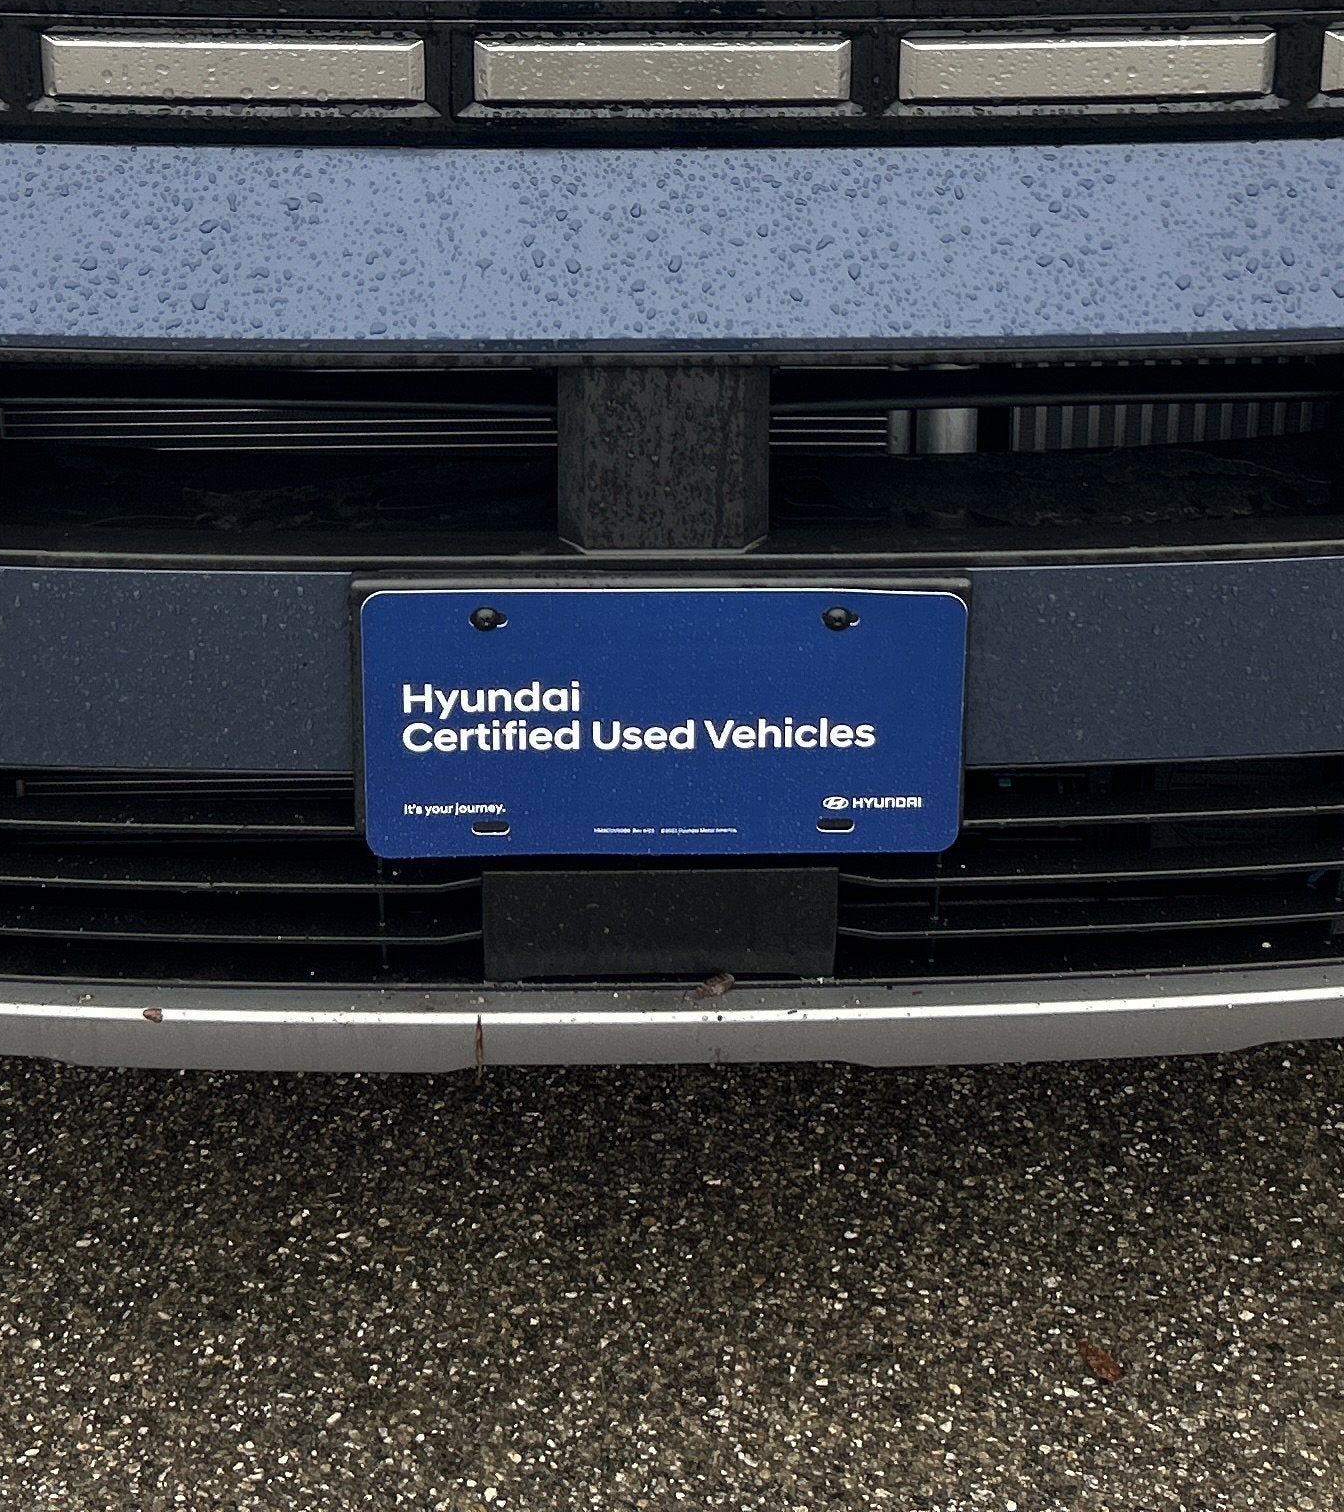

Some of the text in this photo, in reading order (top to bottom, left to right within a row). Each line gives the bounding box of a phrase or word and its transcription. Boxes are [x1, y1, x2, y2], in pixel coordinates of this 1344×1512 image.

[402, 681, 581, 720] Hyundai
[401, 716, 877, 752] Certified Used Vehicles
[403, 803, 423, 815] It's
[424, 804, 454, 816] your
[852, 796, 923, 809] HYUNDAI
